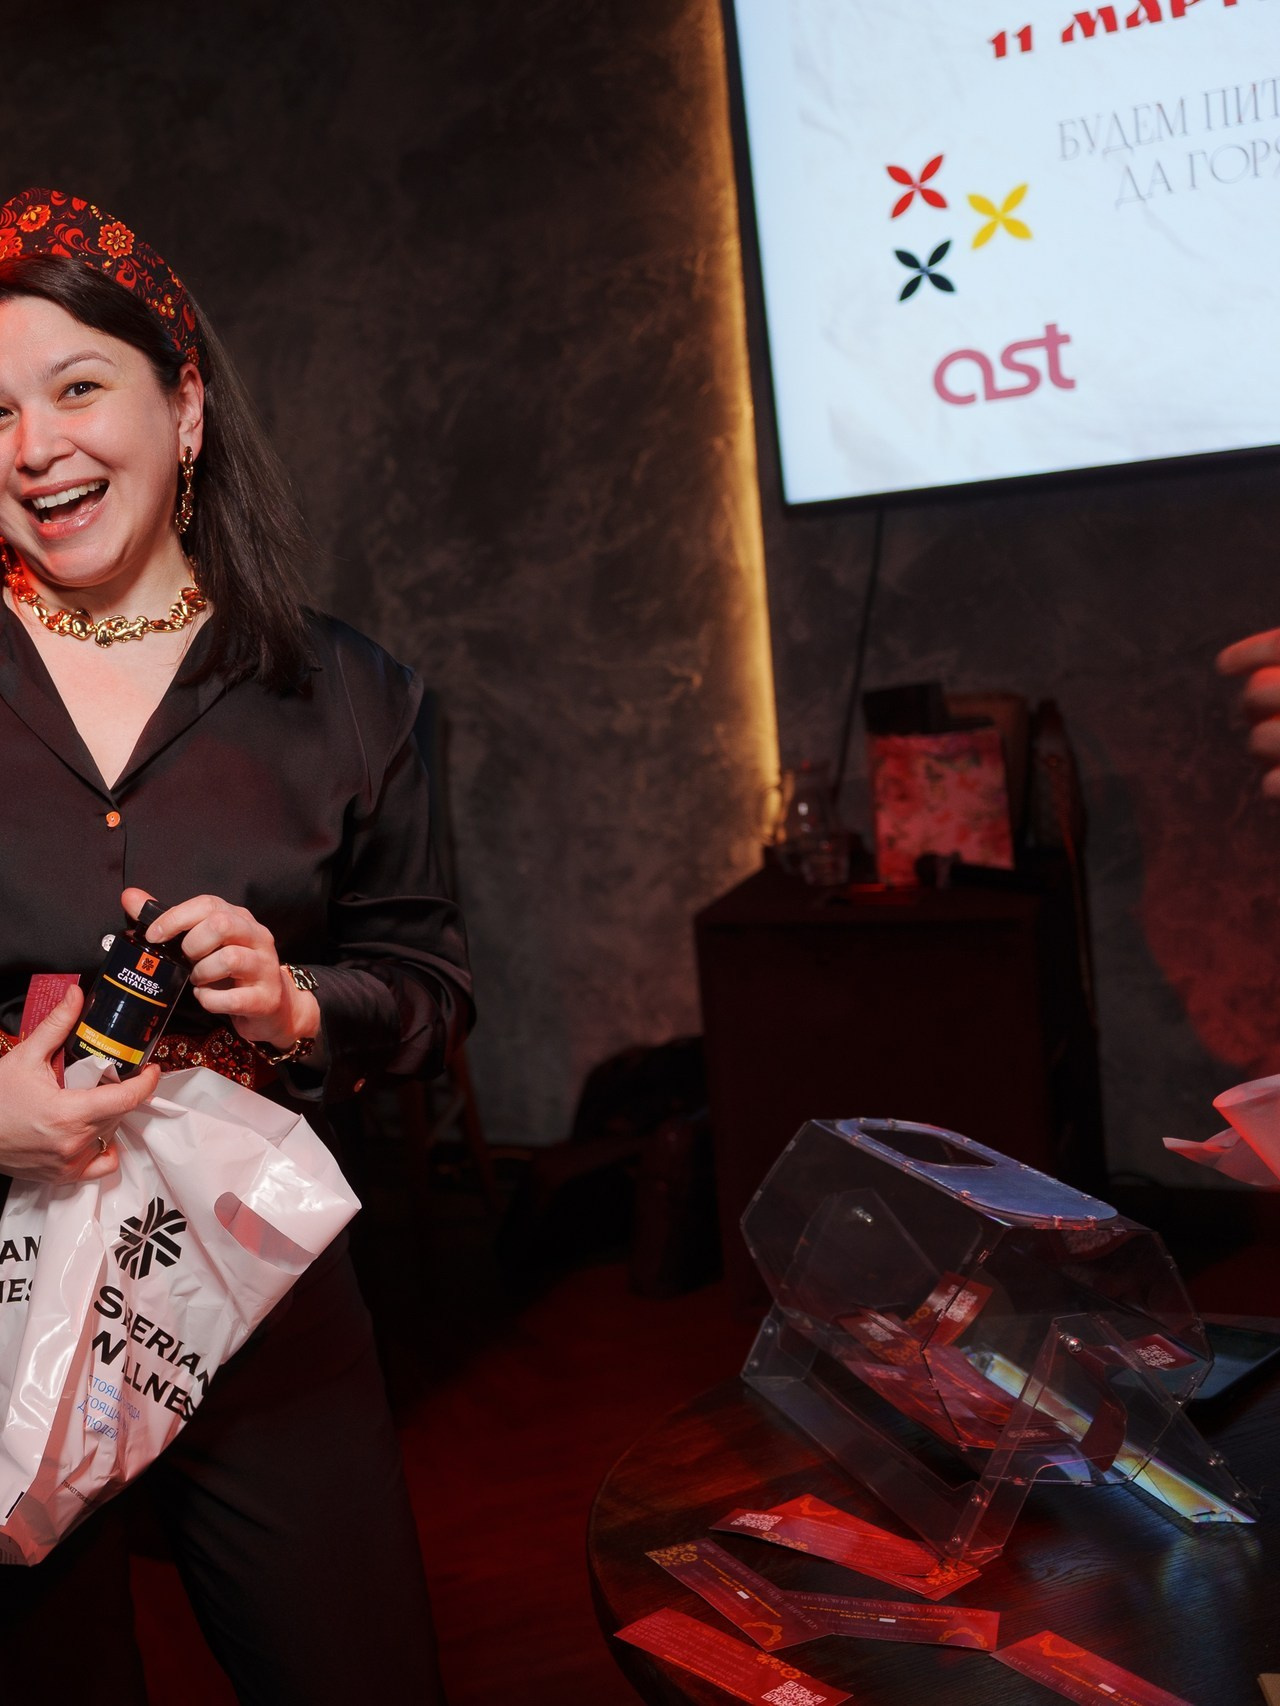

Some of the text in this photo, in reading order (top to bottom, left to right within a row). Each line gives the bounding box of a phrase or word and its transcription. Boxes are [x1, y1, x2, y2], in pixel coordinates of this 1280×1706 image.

[988, 0, 1239, 59] 11 МАР
[1057, 95, 1190, 163] БУДЕМ
[1114, 136, 1280, 212] ДА ГОР
[933, 323, 1077, 406] ast
[117, 972, 160, 997] CATALYST
